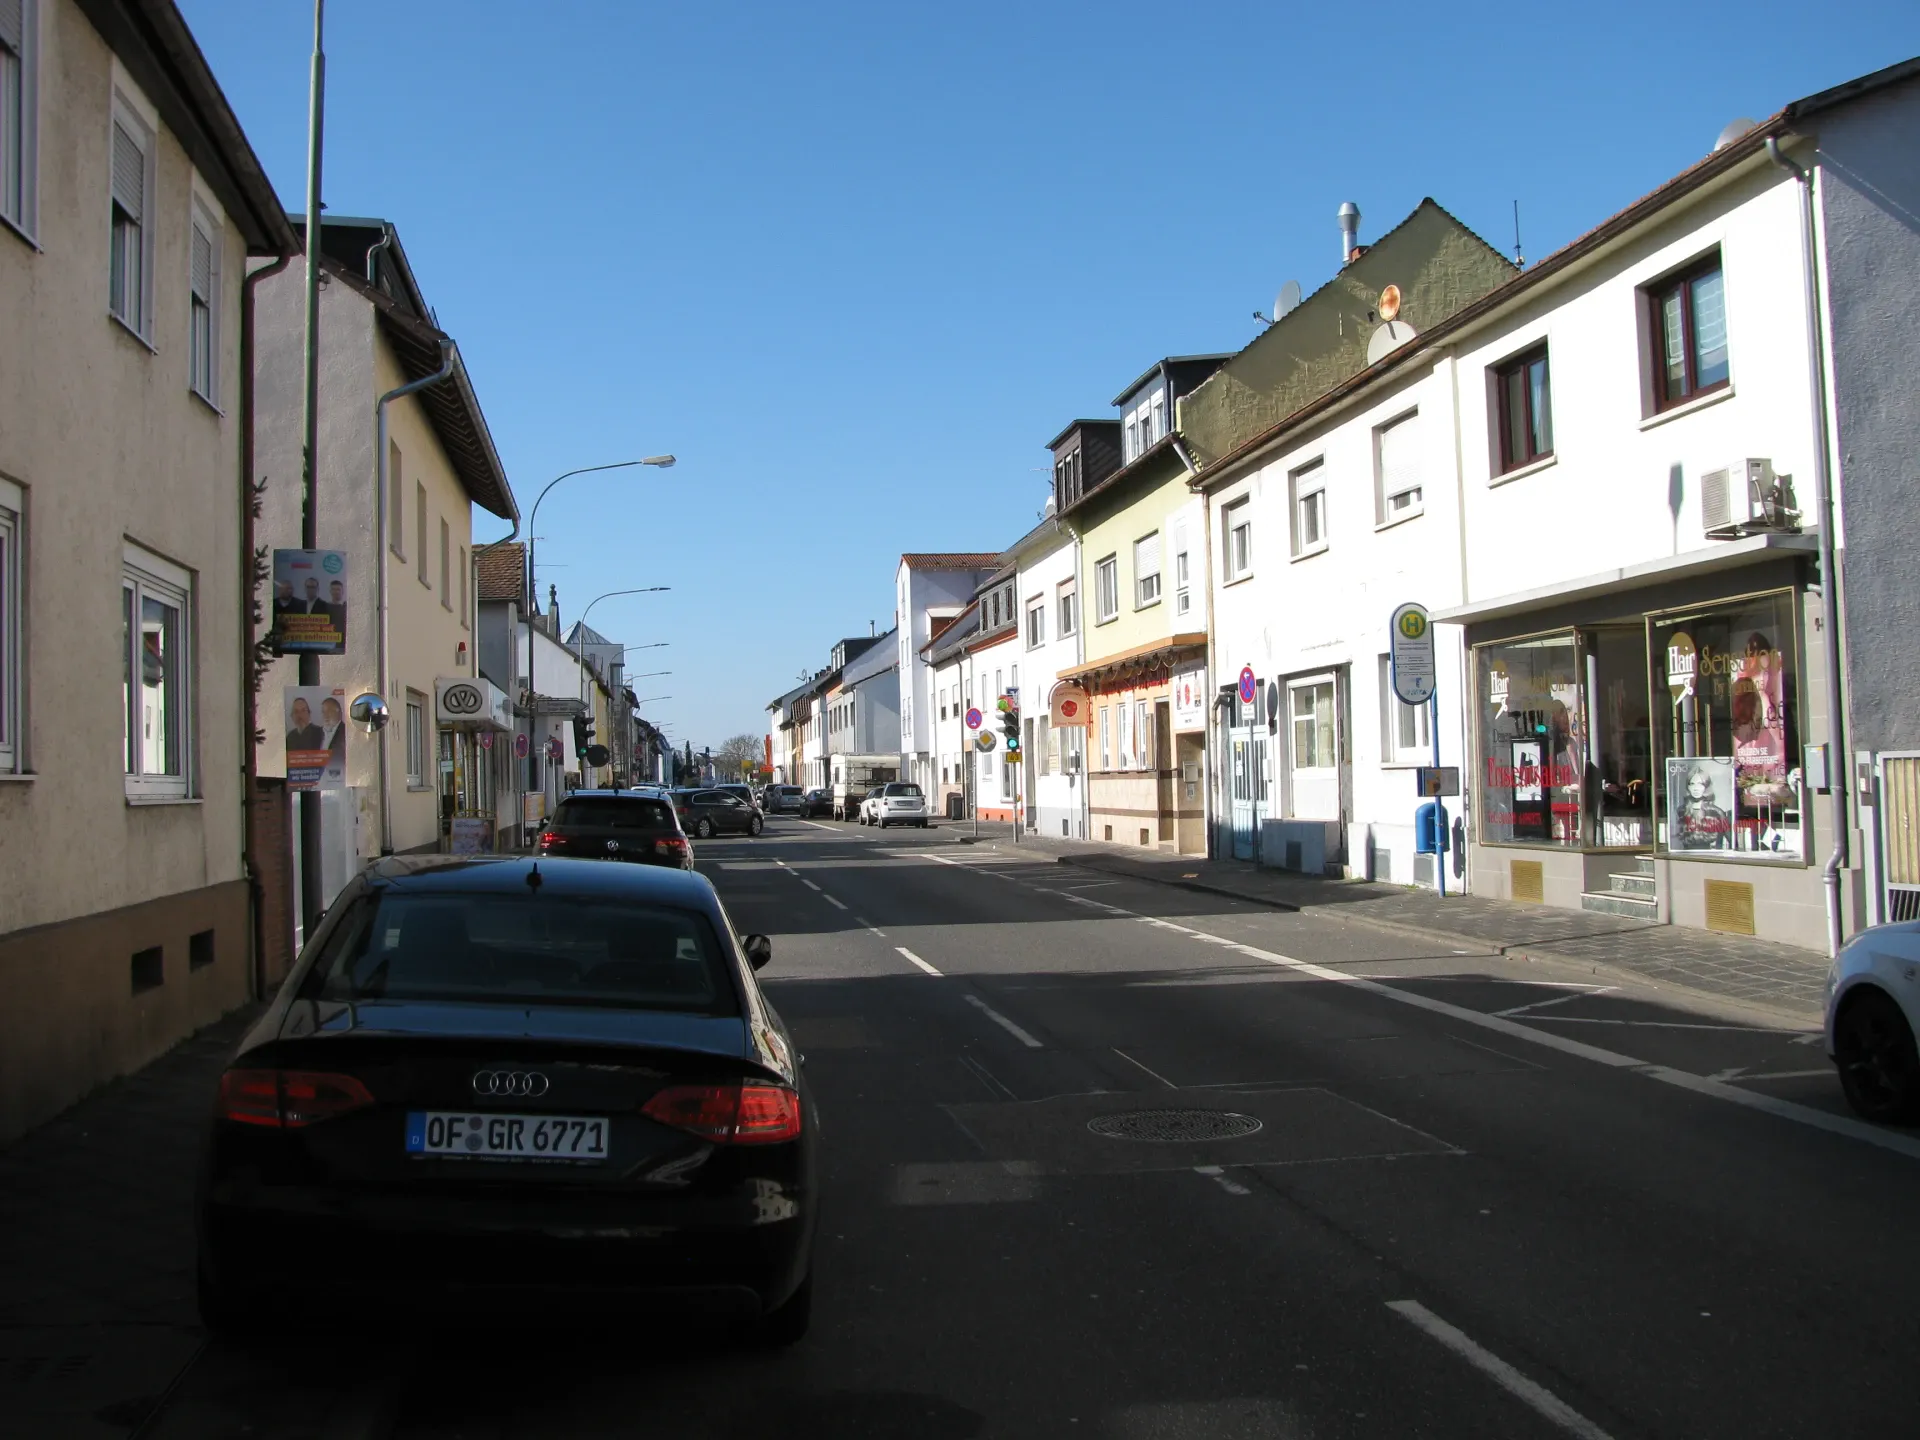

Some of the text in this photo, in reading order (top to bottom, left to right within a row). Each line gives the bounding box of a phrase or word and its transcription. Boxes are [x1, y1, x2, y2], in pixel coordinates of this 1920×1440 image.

[1405, 616, 1419, 633] H
[1668, 643, 1783, 677] Hair Sensation
[1490, 670, 1510, 694] Hair
[427, 1116, 605, 1154] OF GR 6771
